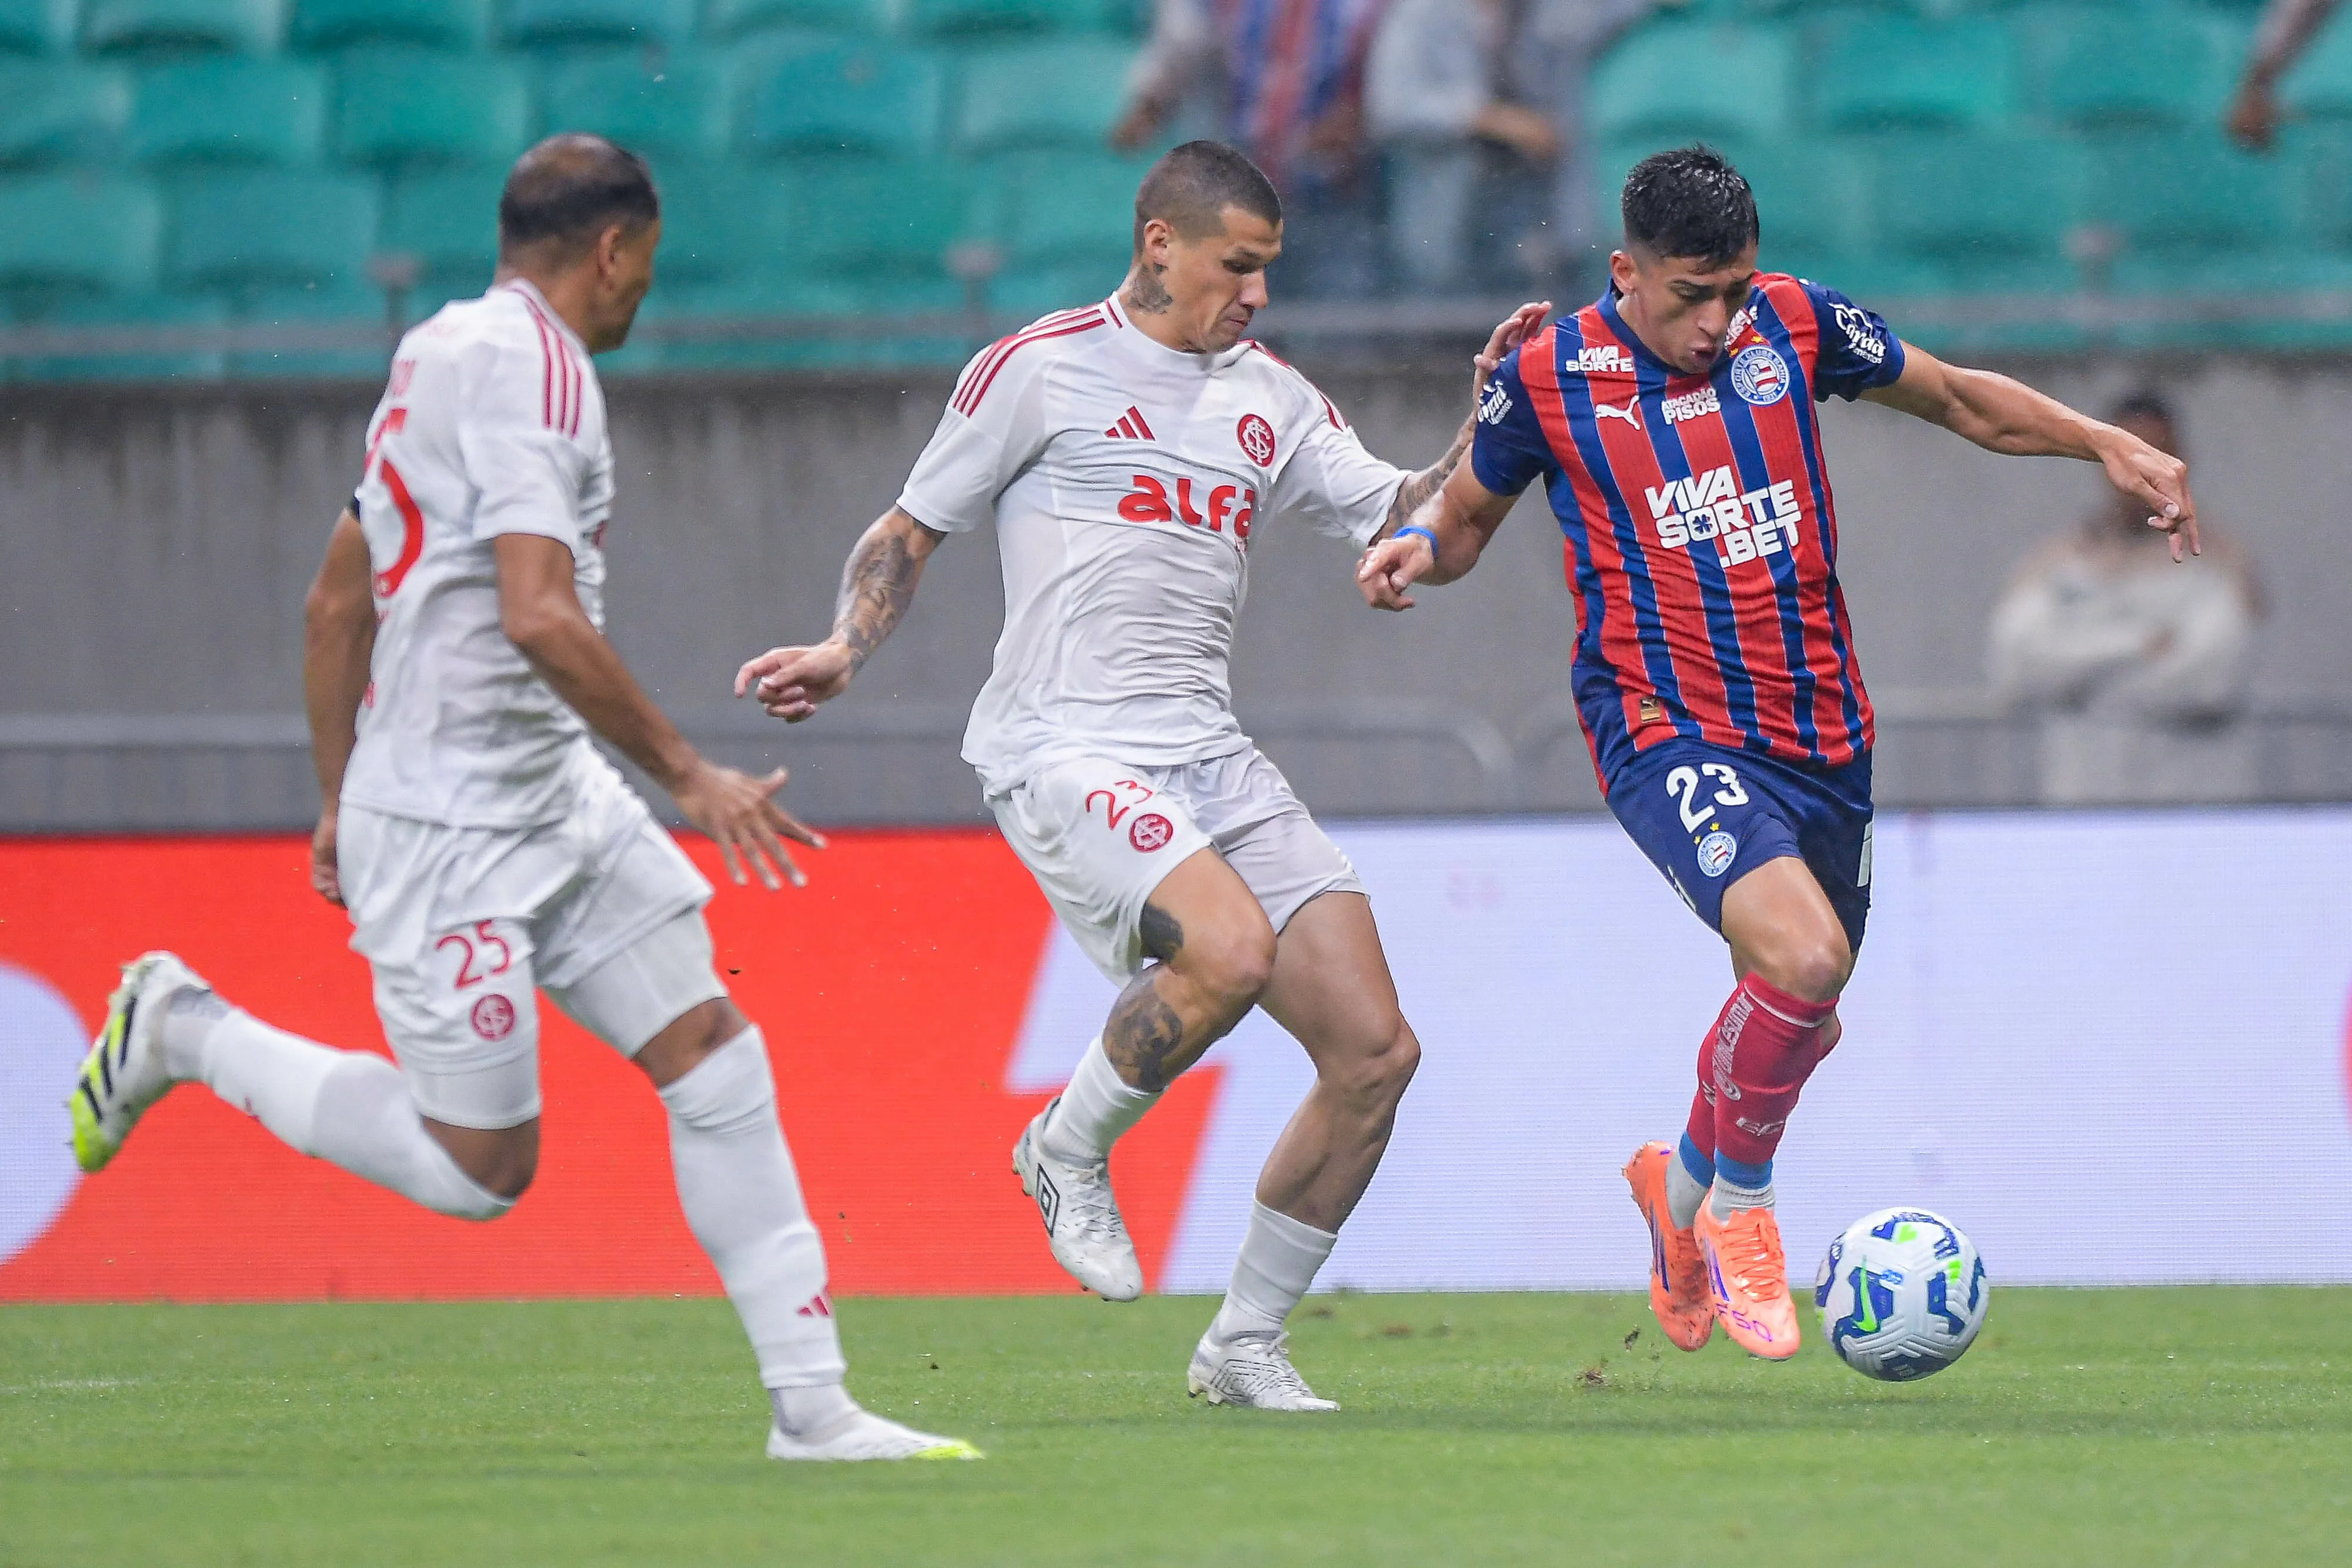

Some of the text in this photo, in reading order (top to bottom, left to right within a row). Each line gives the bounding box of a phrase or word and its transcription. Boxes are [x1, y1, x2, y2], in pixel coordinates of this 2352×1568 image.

[1565, 356, 1634, 373] SORTE
[1578, 345, 1619, 363] VIVA
[1663, 397, 1721, 425] PISOS
[1643, 464, 1738, 520] VIVA
[1655, 479, 1800, 549] SORTE
[1719, 510, 1803, 569] .BET
[1085, 780, 1153, 831] 23
[1666, 763, 1750, 834] 23
[435, 918, 511, 991] 25
